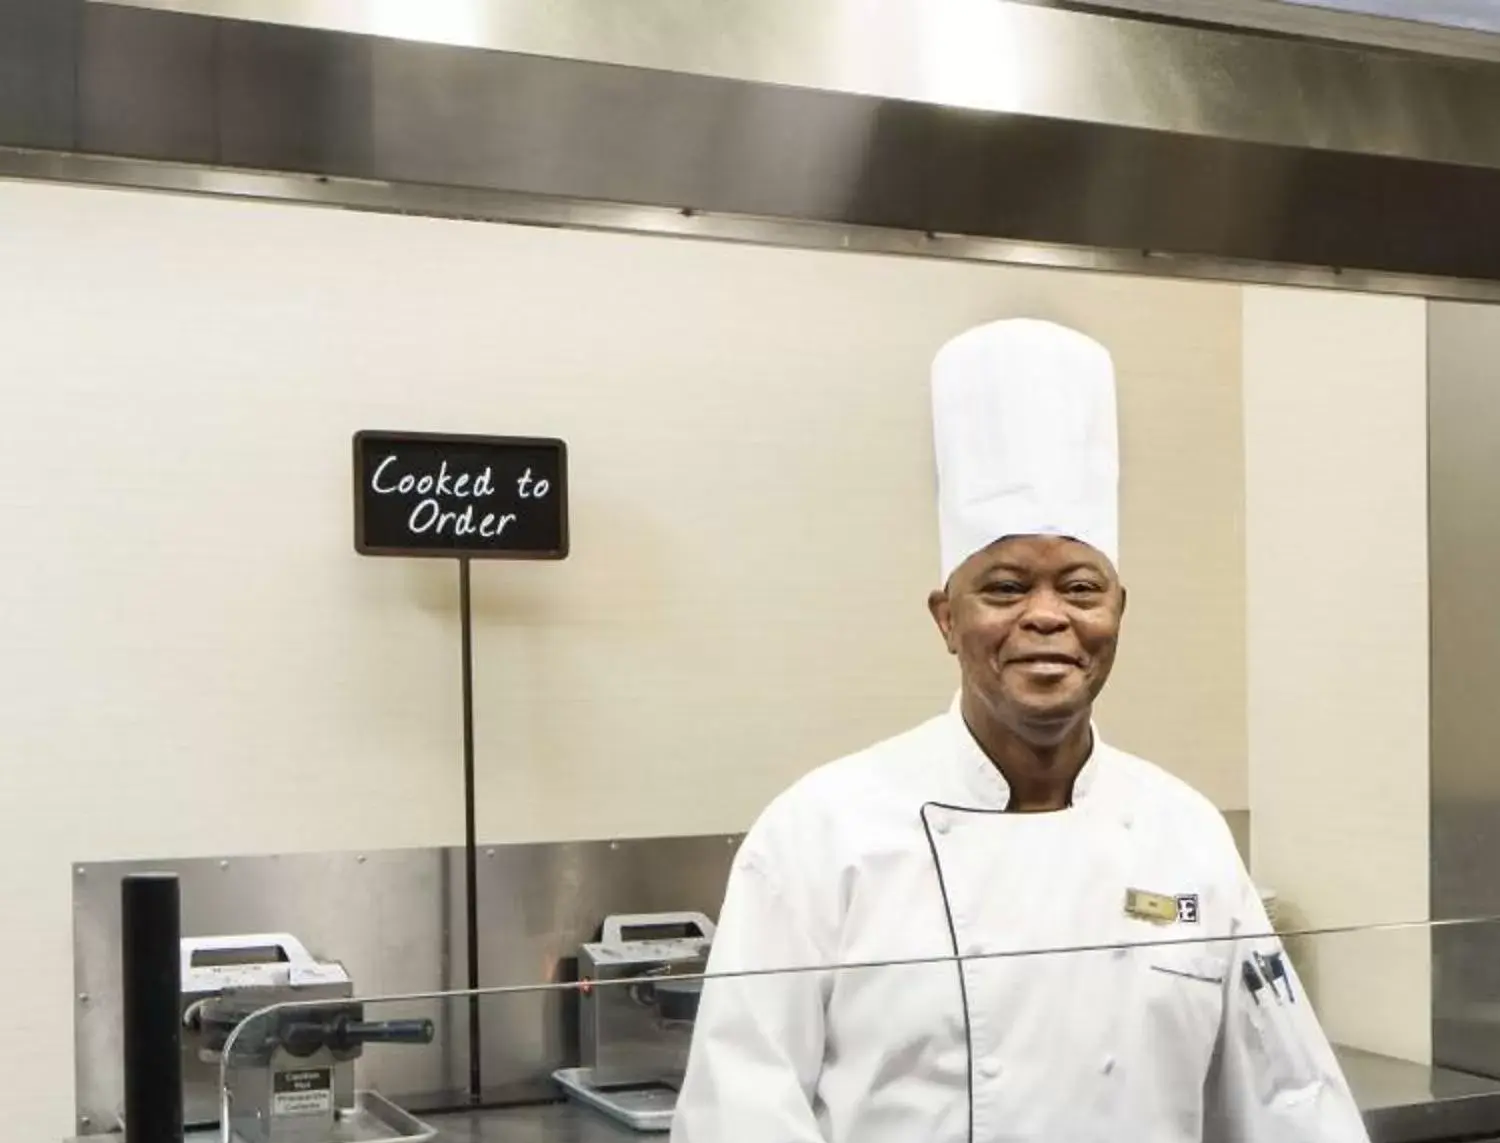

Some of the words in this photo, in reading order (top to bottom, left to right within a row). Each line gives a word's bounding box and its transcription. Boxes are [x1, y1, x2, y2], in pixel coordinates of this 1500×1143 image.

[371, 455, 495, 497] Cooked
[517, 467, 550, 498] to
[408, 498, 516, 537] Order
